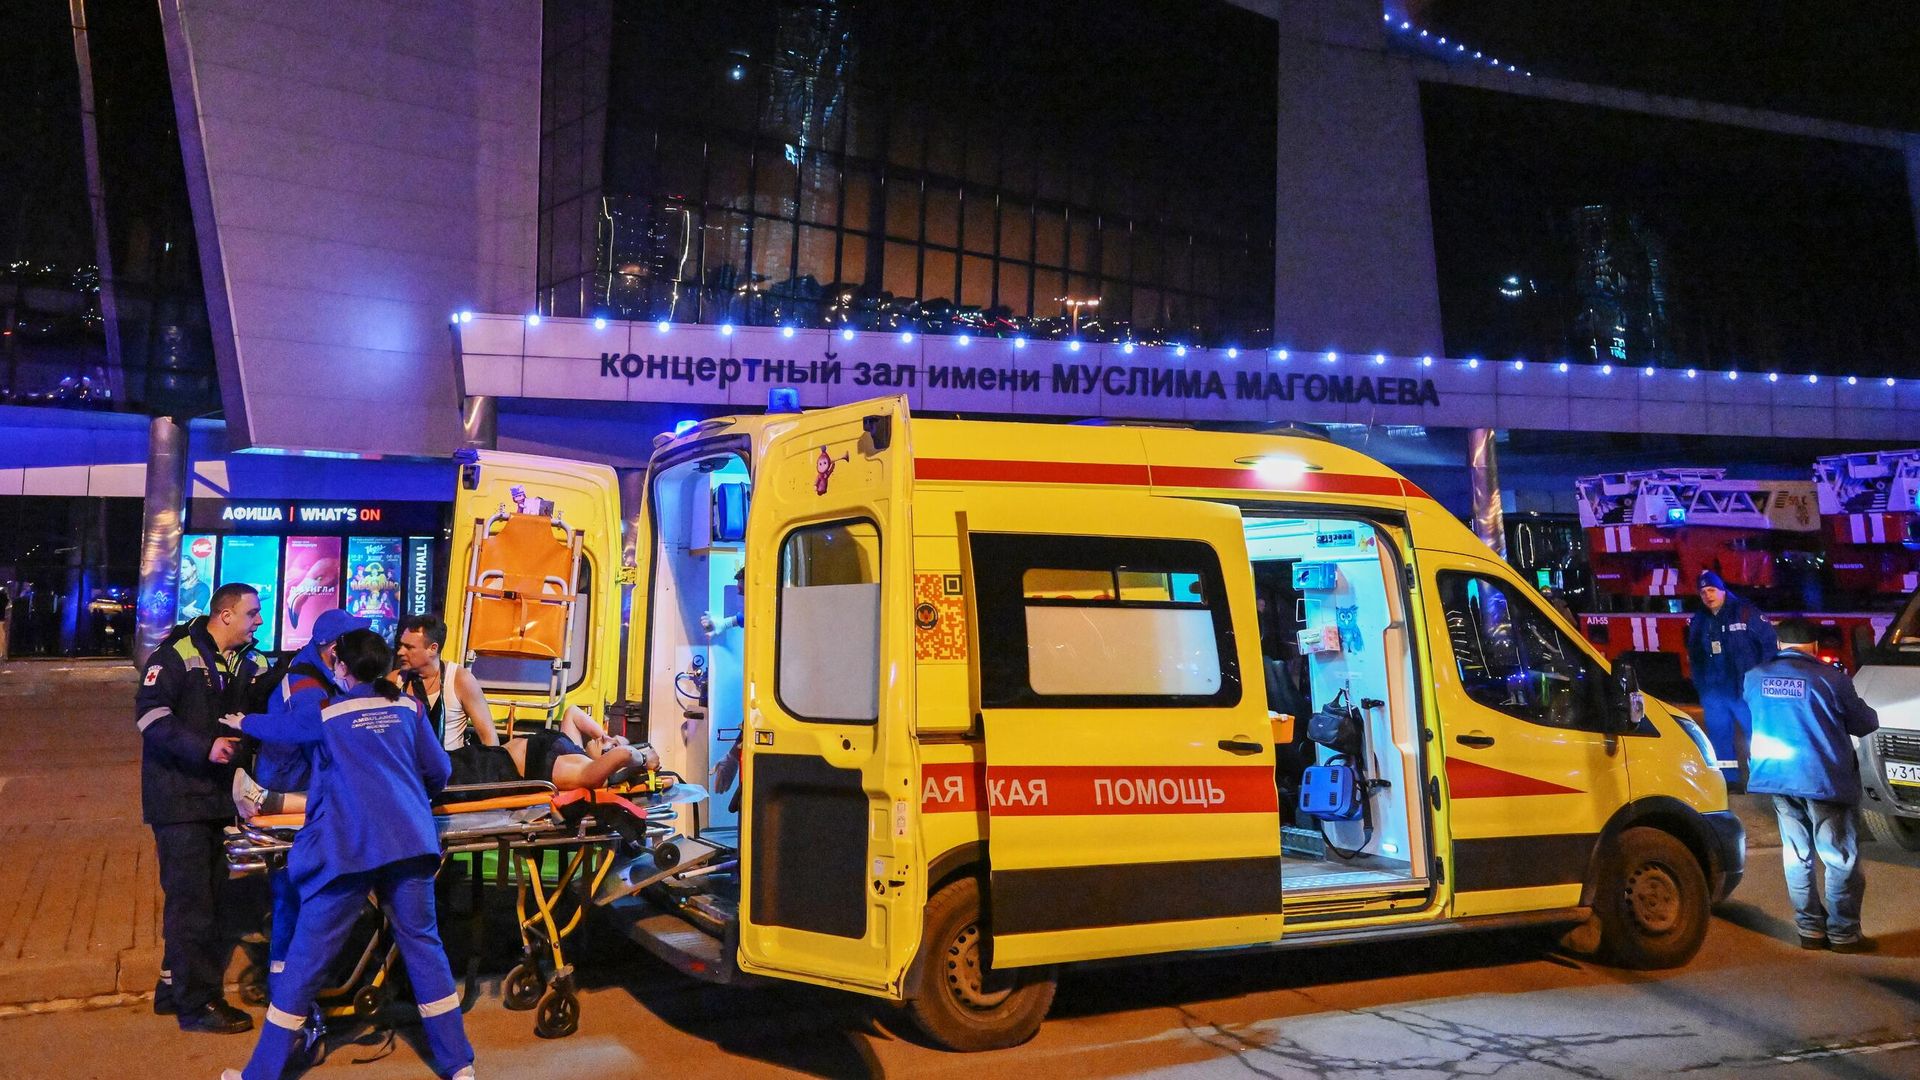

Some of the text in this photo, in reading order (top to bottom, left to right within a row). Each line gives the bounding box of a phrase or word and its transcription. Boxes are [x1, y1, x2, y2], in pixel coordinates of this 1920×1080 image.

[600, 352, 1441, 407] концертный зал имени МУСЛИМА МАГОМАЕВА
[222, 506, 283, 521] АФИША
[300, 507, 381, 521] WHAT'S ON
[414, 543, 428, 616] CUS CITY HALL
[1763, 678, 1803, 688] СКОРАЯ
[1763, 687, 1802, 697] ПОМОЩЬ
[989, 778, 1226, 808] КАЯ ПОМОЩЬ
